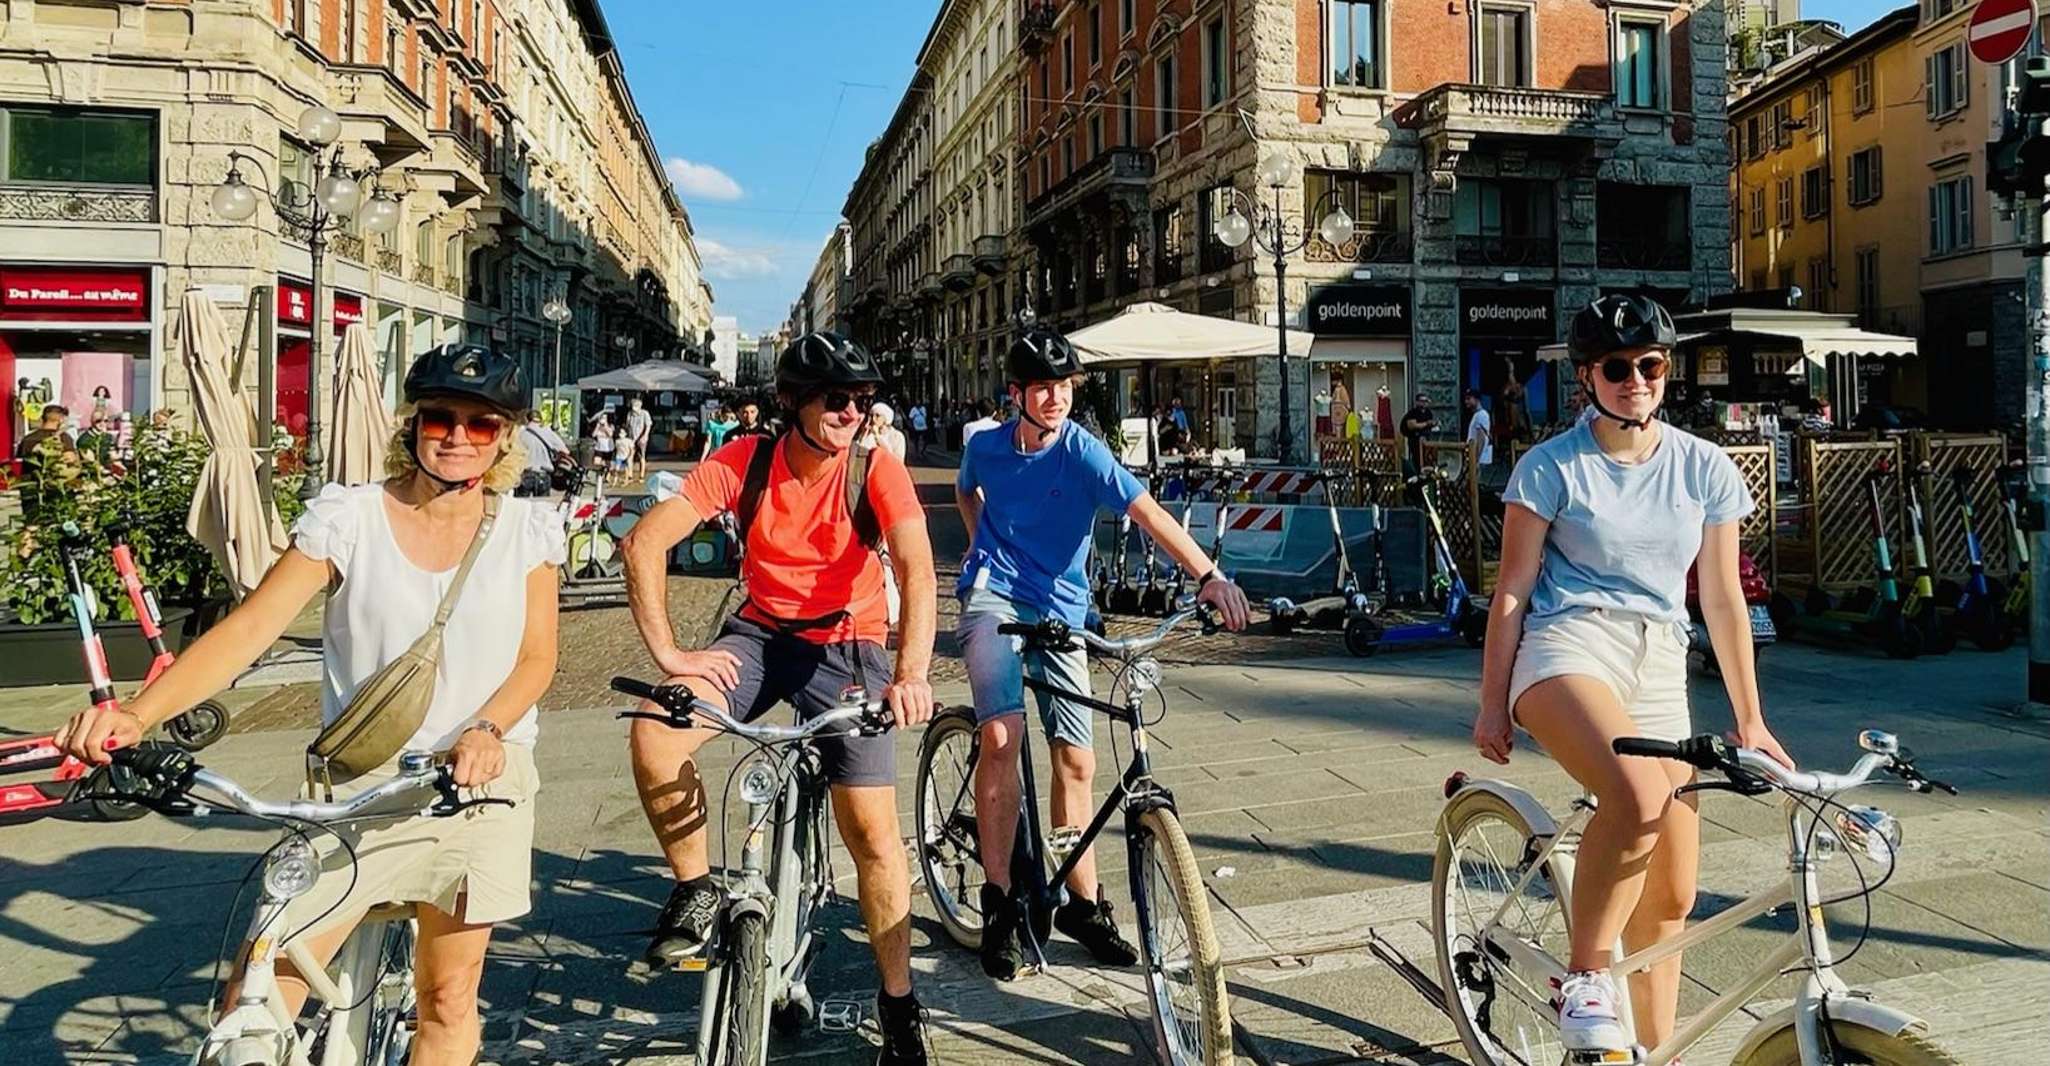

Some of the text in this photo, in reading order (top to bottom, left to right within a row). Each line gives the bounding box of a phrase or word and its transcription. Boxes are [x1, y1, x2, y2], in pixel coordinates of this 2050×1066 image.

[9, 288, 29, 299] Du
[1318, 301, 1402, 321] goldenpoint
[1469, 304, 1548, 322] goldenpoint
